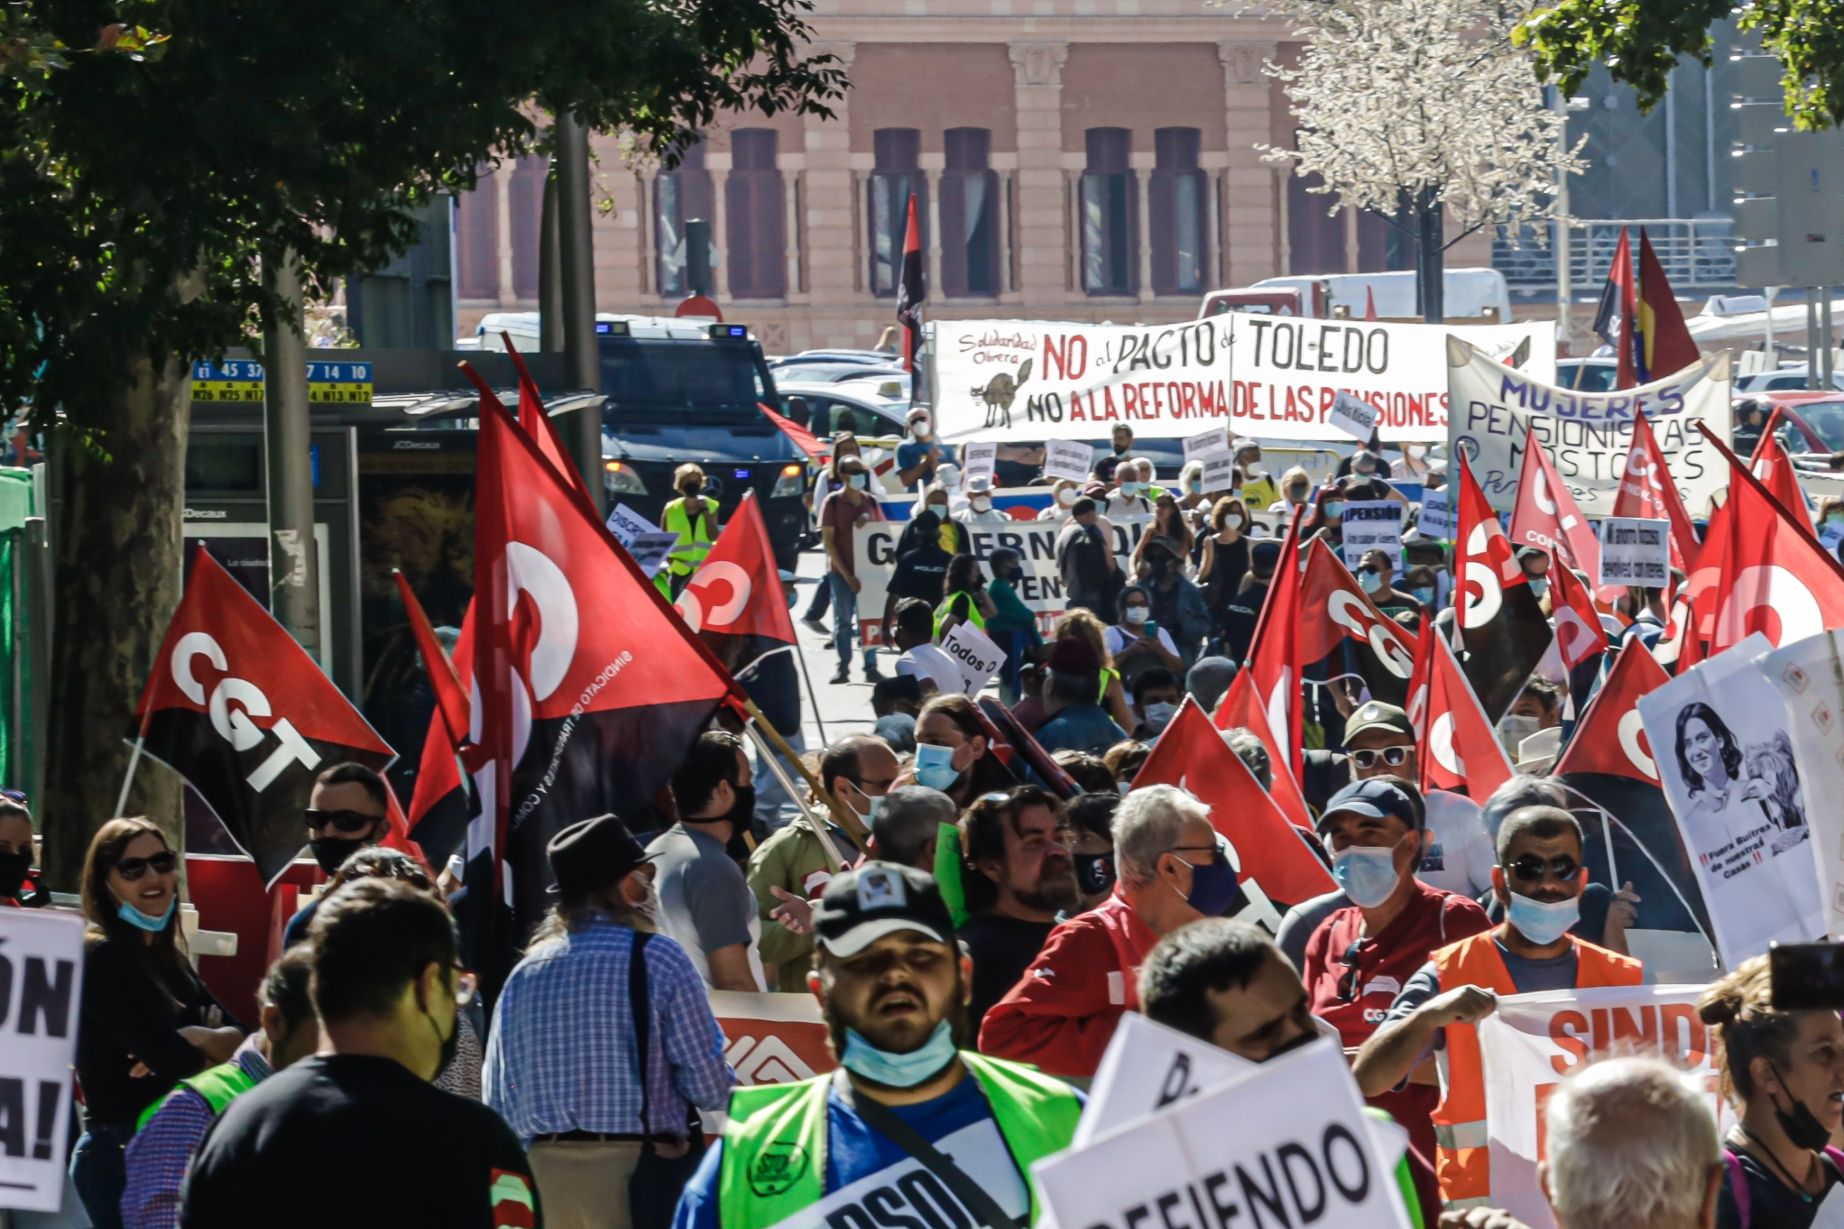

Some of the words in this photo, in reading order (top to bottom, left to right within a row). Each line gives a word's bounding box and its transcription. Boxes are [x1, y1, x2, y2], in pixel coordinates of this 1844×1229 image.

[1043, 334, 1087, 380] NO
[1096, 341, 1112, 367] al
[1112, 320, 1215, 374] PACTO
[1221, 321, 1237, 349] de
[1249, 319, 1389, 374] TOLEDO
[221, 364, 238, 377] 45
[247, 364, 263, 378] 37
[323, 365, 339, 379] 14
[352, 365, 366, 379] 10
[1027, 392, 1063, 423] NO
[1088, 385, 1119, 421] LA
[1122, 379, 1228, 420] REFORMA
[1232, 380, 1265, 420] DE
[1269, 384, 1314, 423] LAS
[1320, 387, 1448, 427] PSIONES
[1500, 374, 1684, 419] MUJERES
[945, 634, 985, 672] Todos
[171, 631, 322, 794] CGT
[1735, 823, 1771, 845] Buitres
[1711, 863, 1723, 873] de
[1725, 837, 1765, 865] nuestras
[1723, 861, 1751, 879] Casas
